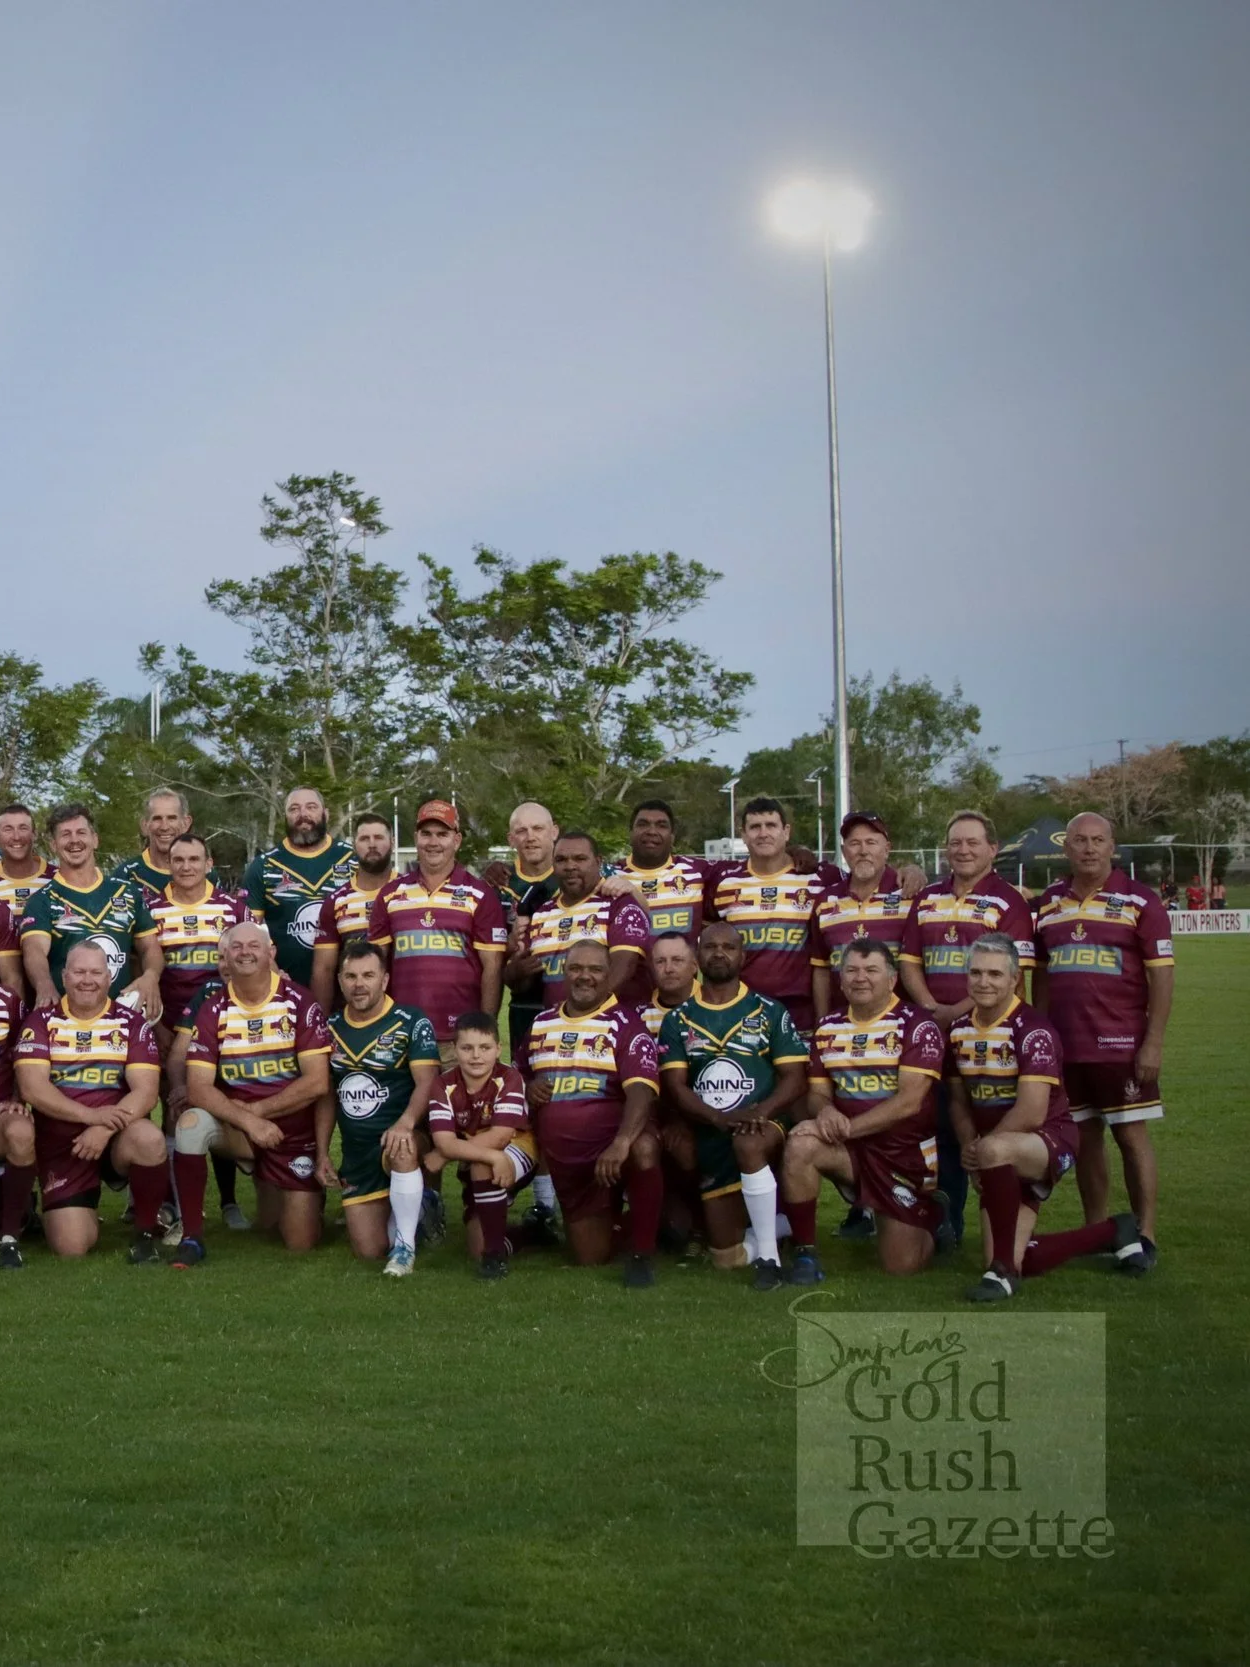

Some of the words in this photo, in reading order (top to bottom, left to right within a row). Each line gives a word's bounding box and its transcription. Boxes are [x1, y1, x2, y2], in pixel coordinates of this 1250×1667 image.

[288, 920, 319, 932] MIN
[652, 912, 689, 929] BE
[1200, 913, 1240, 931] PRINTERS
[396, 935, 463, 952] QUBE
[925, 951, 965, 967] QUB
[221, 1056, 297, 1080] QUBE
[838, 1075, 899, 1092] UBE
